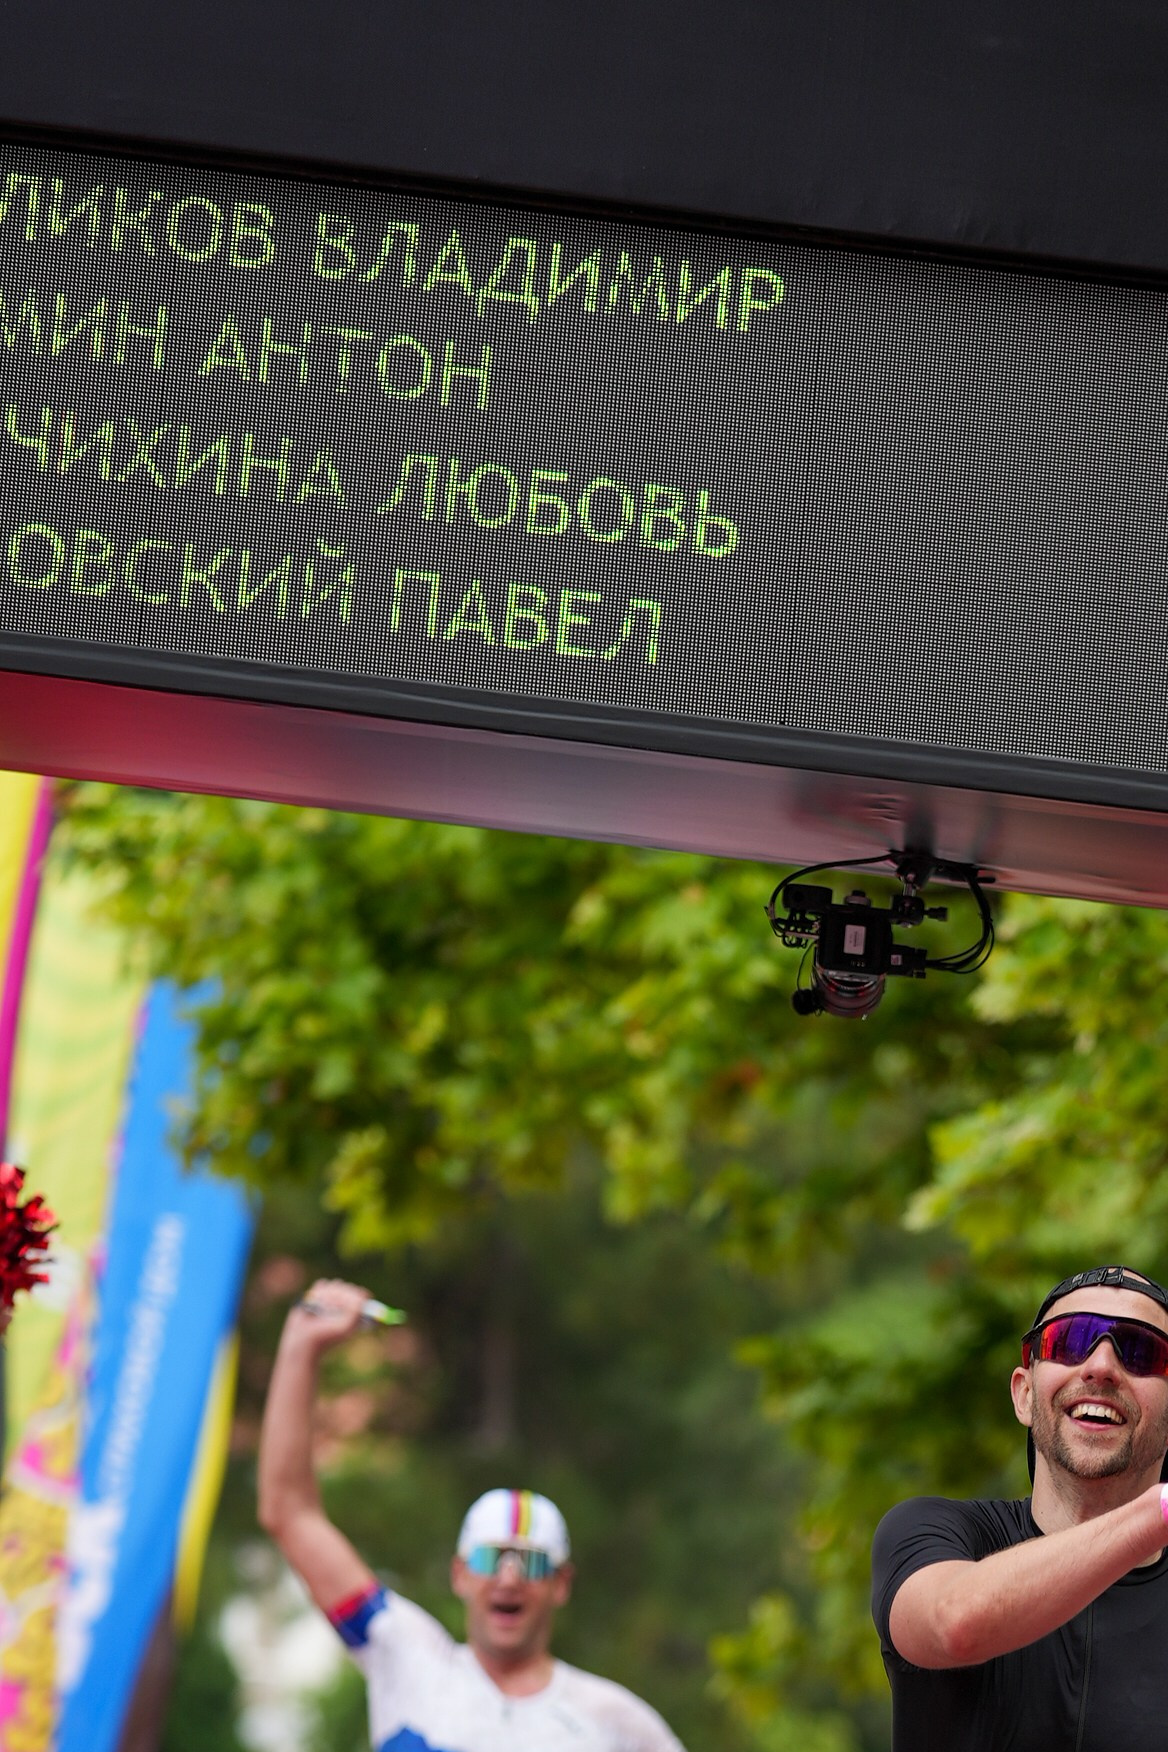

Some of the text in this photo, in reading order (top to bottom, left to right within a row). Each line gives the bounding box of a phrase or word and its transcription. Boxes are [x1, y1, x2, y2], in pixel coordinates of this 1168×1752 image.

[313, 212, 786, 332] ВЛАДИМИР
[198, 314, 494, 411] АНТОН
[4, 402, 740, 559] ЧИХИНА ЛЮБОВЬ
[7, 520, 664, 667] ОВСКИЙ ПАВЕЛ
